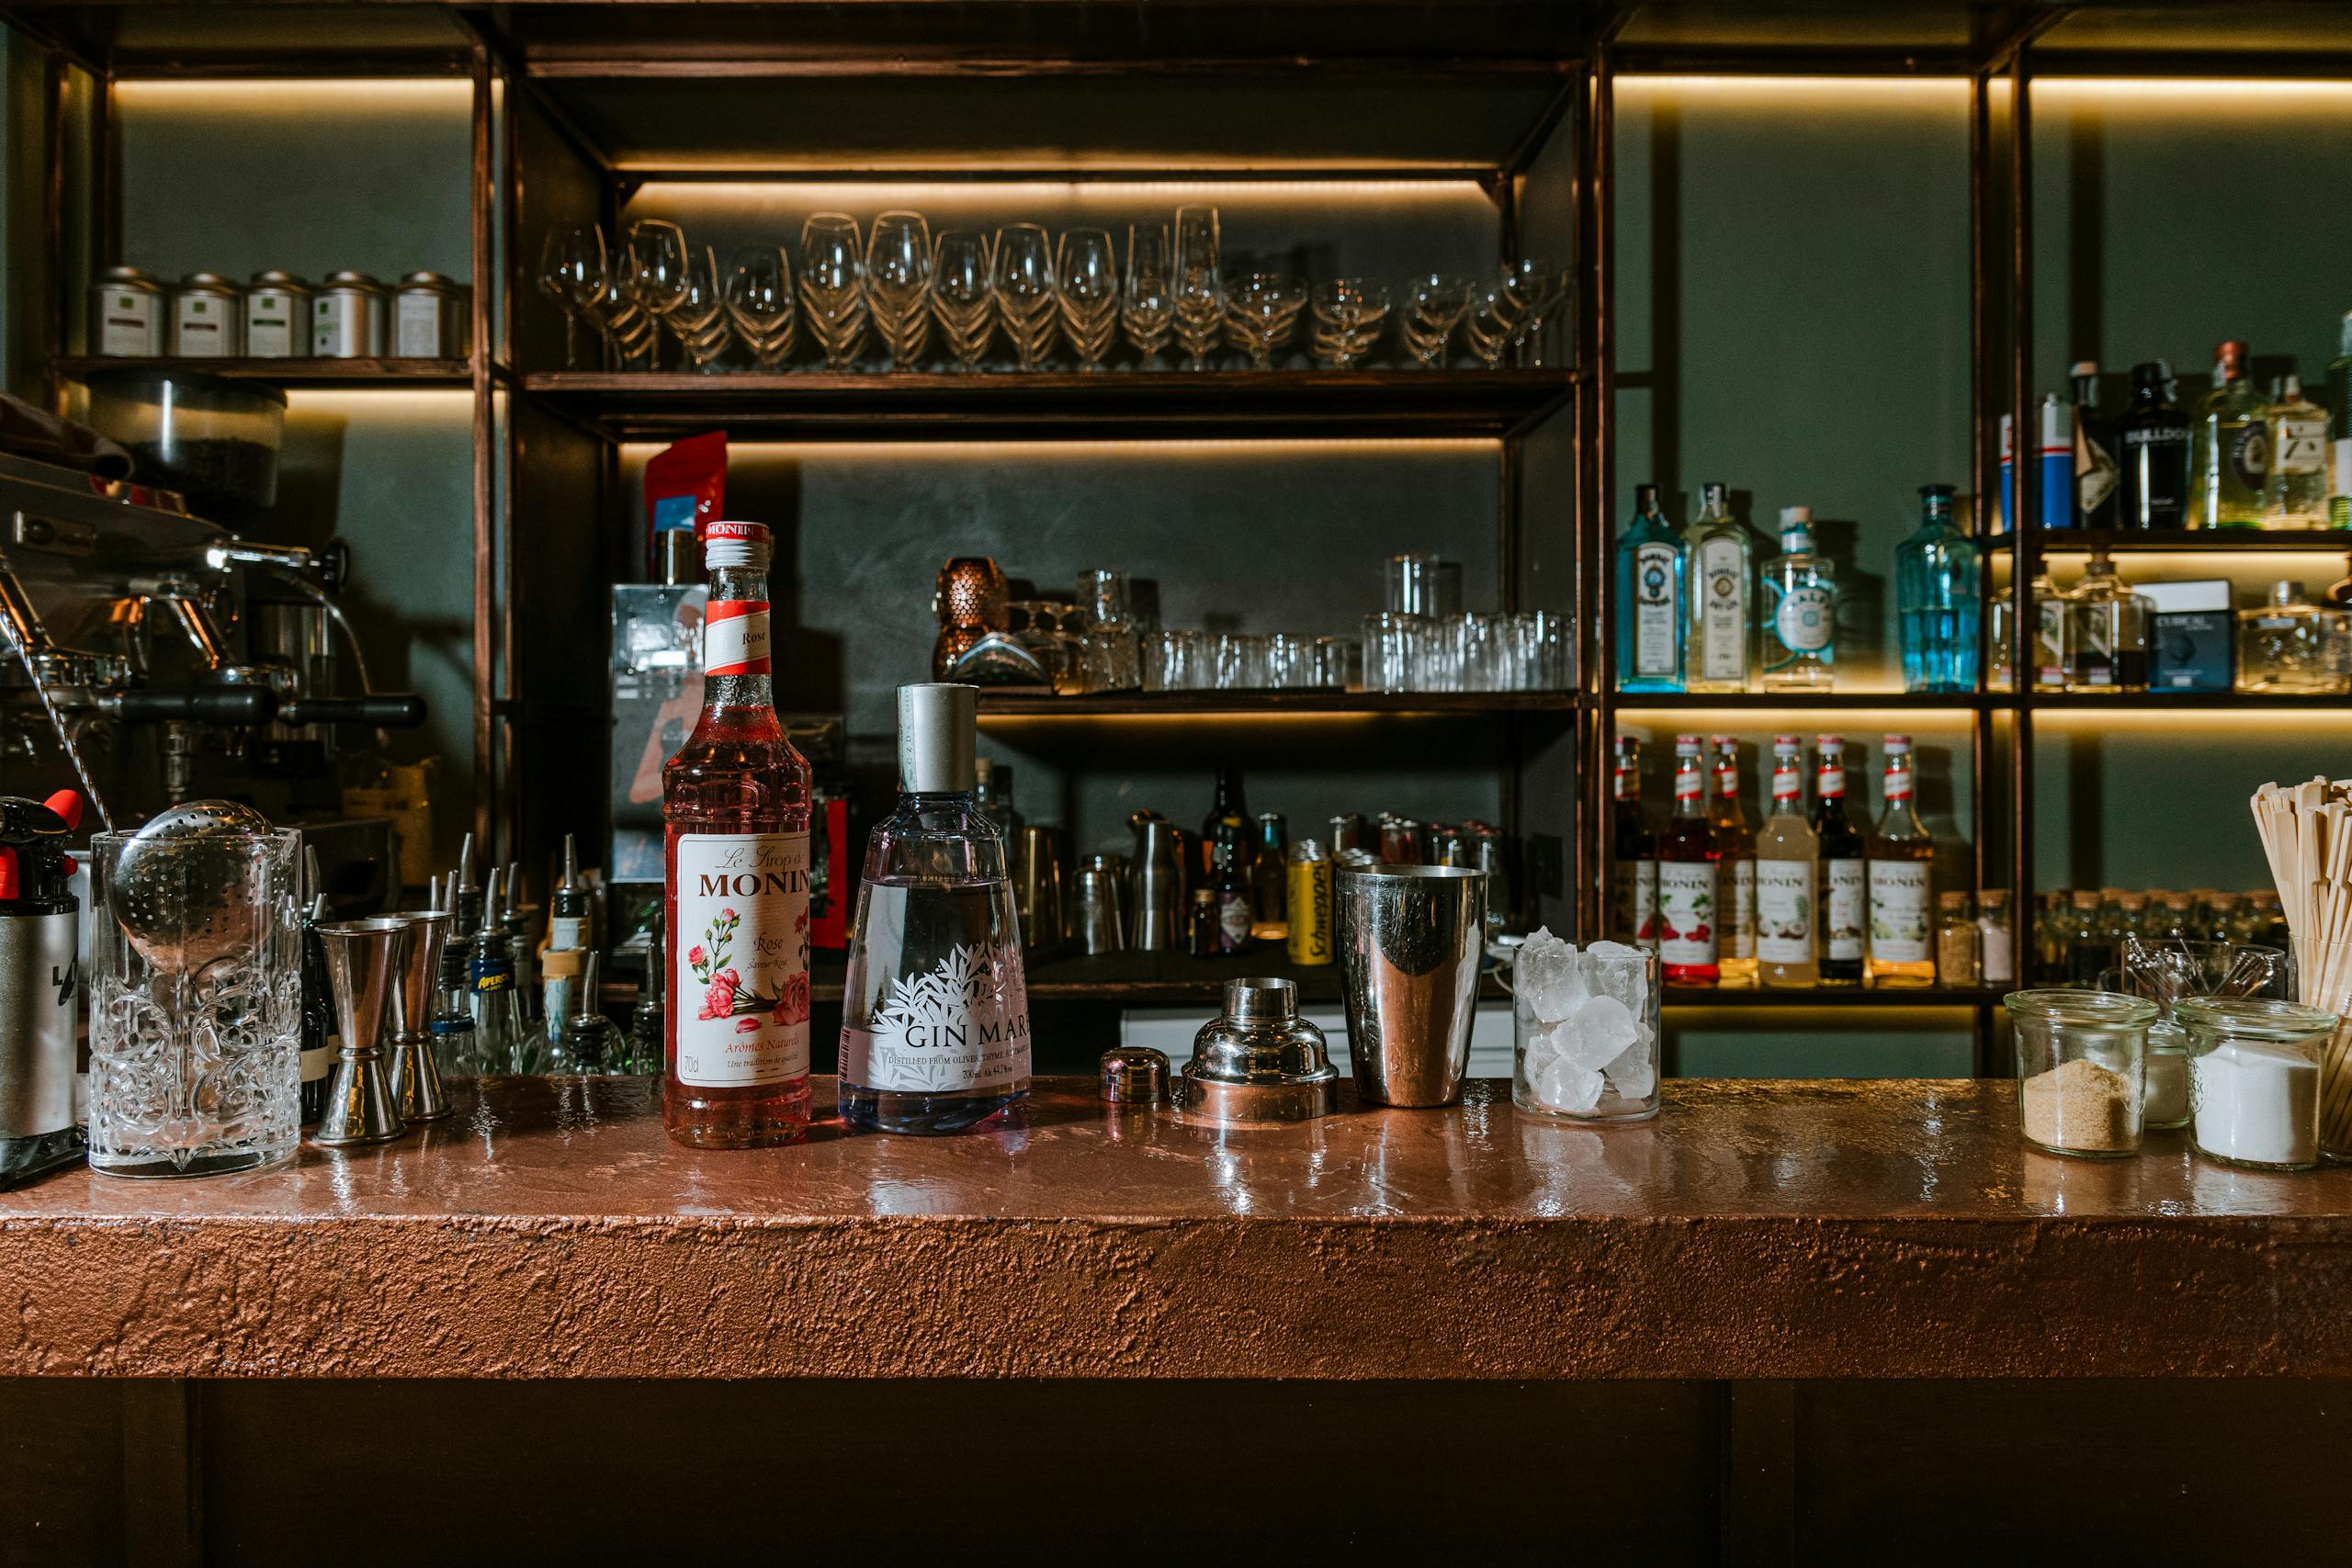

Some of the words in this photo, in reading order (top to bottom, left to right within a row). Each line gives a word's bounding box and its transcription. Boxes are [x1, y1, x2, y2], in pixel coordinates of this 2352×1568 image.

[714, 847, 745, 868] Le
[749, 845, 792, 873] Sirop
[698, 868, 808, 897] MONIN
[1309, 863, 1329, 957] Schweppes
[753, 931, 784, 955] Rose
[905, 1024, 967, 1048] GIN
[727, 1060, 742, 1068] Une
[888, 1056, 927, 1066] DISTILLED
[929, 1055, 951, 1066] FROM
